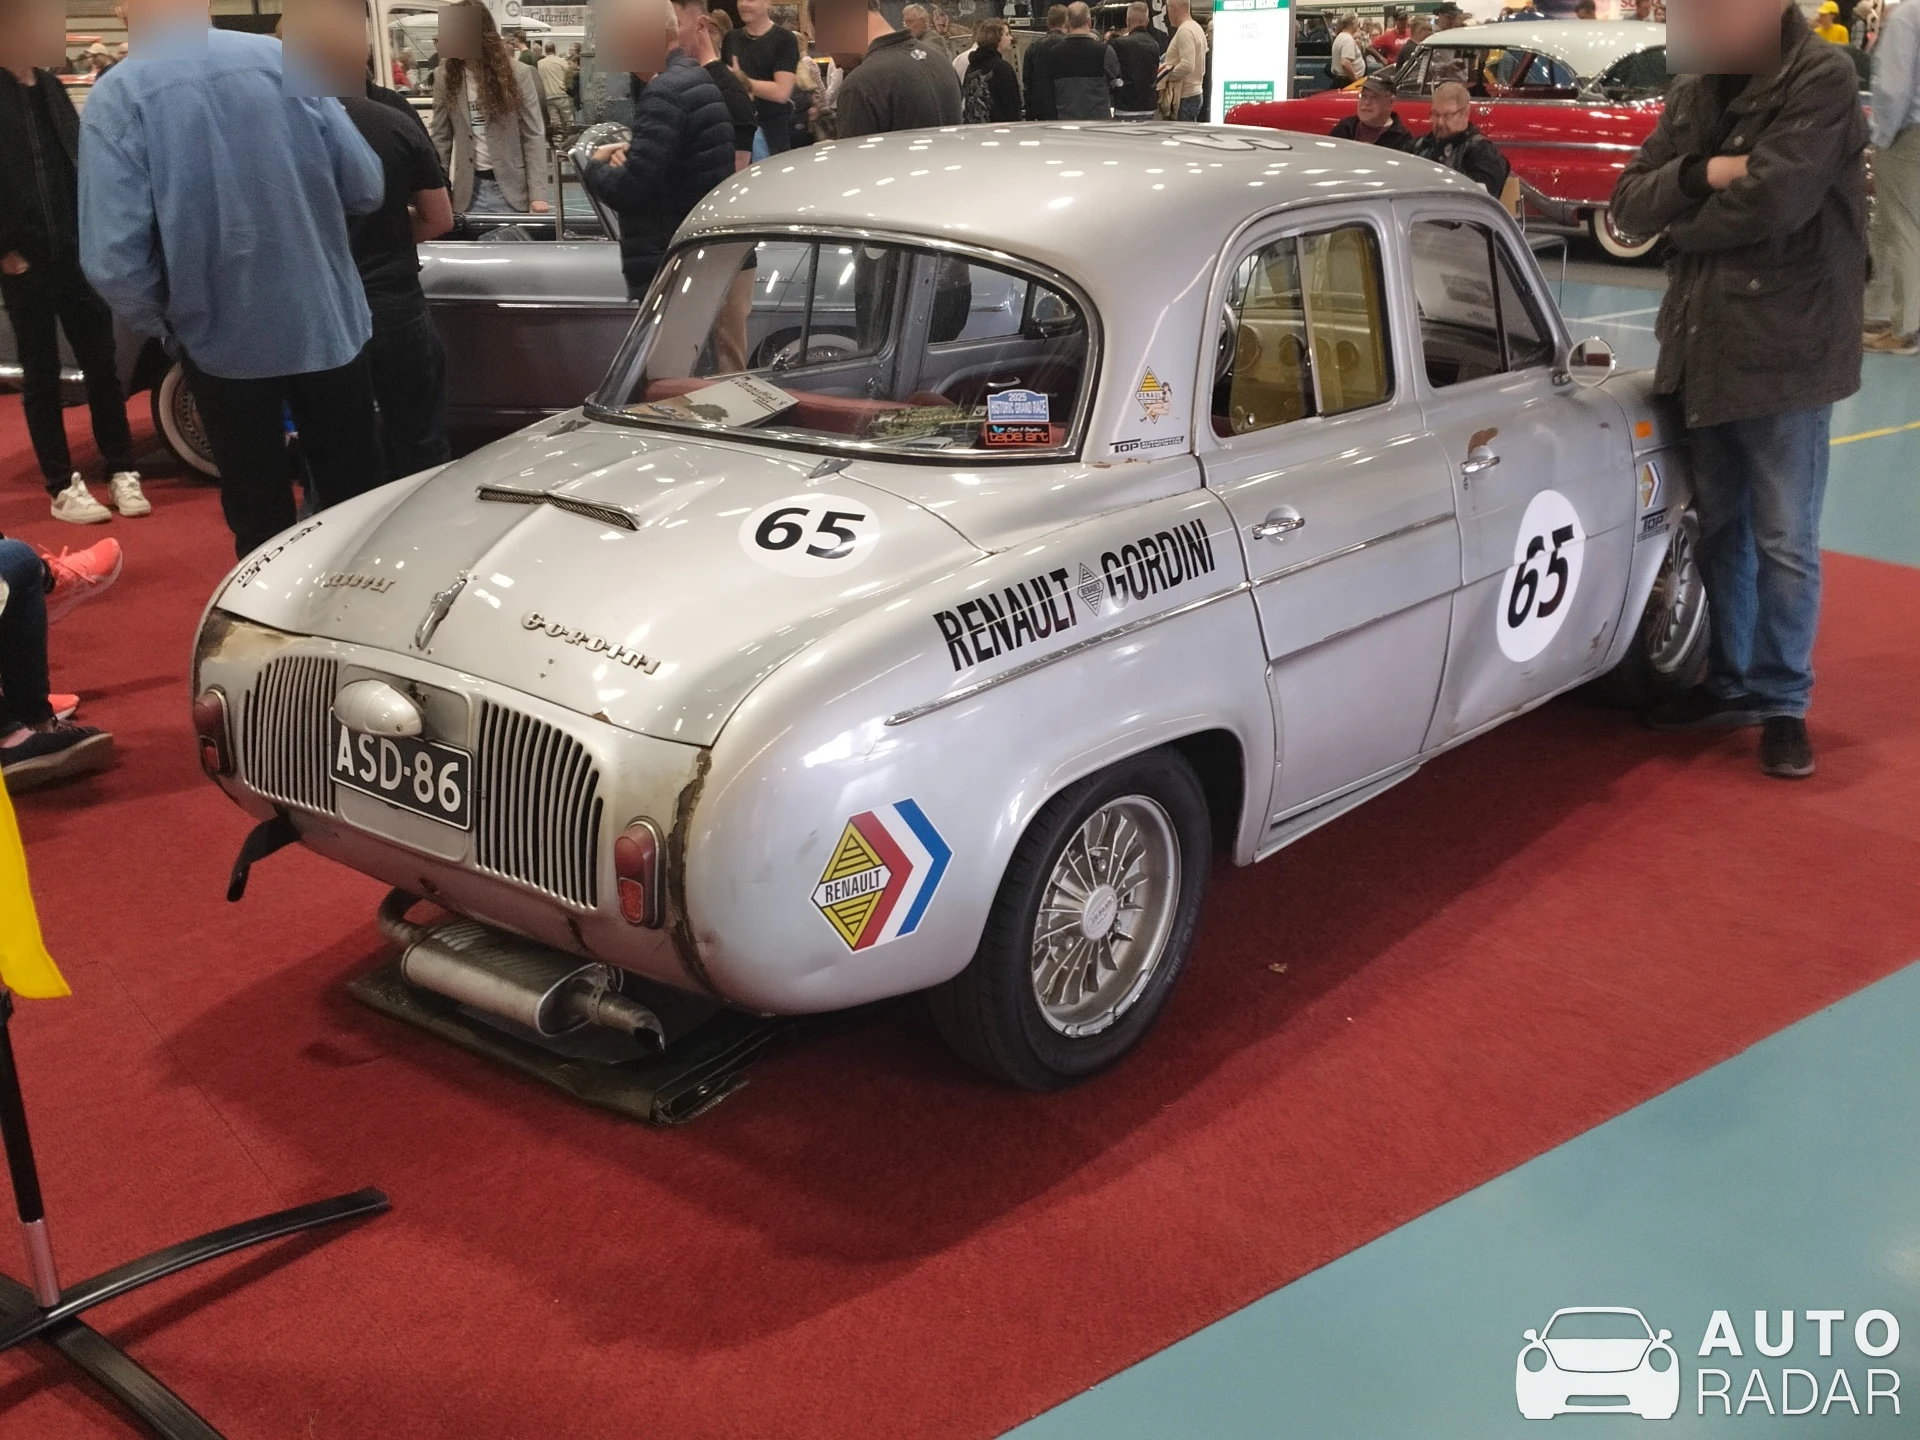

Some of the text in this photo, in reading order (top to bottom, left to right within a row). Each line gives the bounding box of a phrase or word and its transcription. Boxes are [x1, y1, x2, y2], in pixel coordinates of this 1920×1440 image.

[530, 11, 576, 25] Catering
[1008, 392, 1027, 401] 2025
[989, 431, 1049, 443] tape art
[1110, 438, 1141, 453] TOP
[755, 507, 866, 560] 65
[1641, 507, 1668, 532] TOP
[1507, 523, 1575, 628] 65
[932, 567, 1078, 672] RENAULT
[1100, 518, 1216, 609] GORDINI
[336, 724, 461, 812] ASD-86
[825, 869, 881, 903] RENAULT
